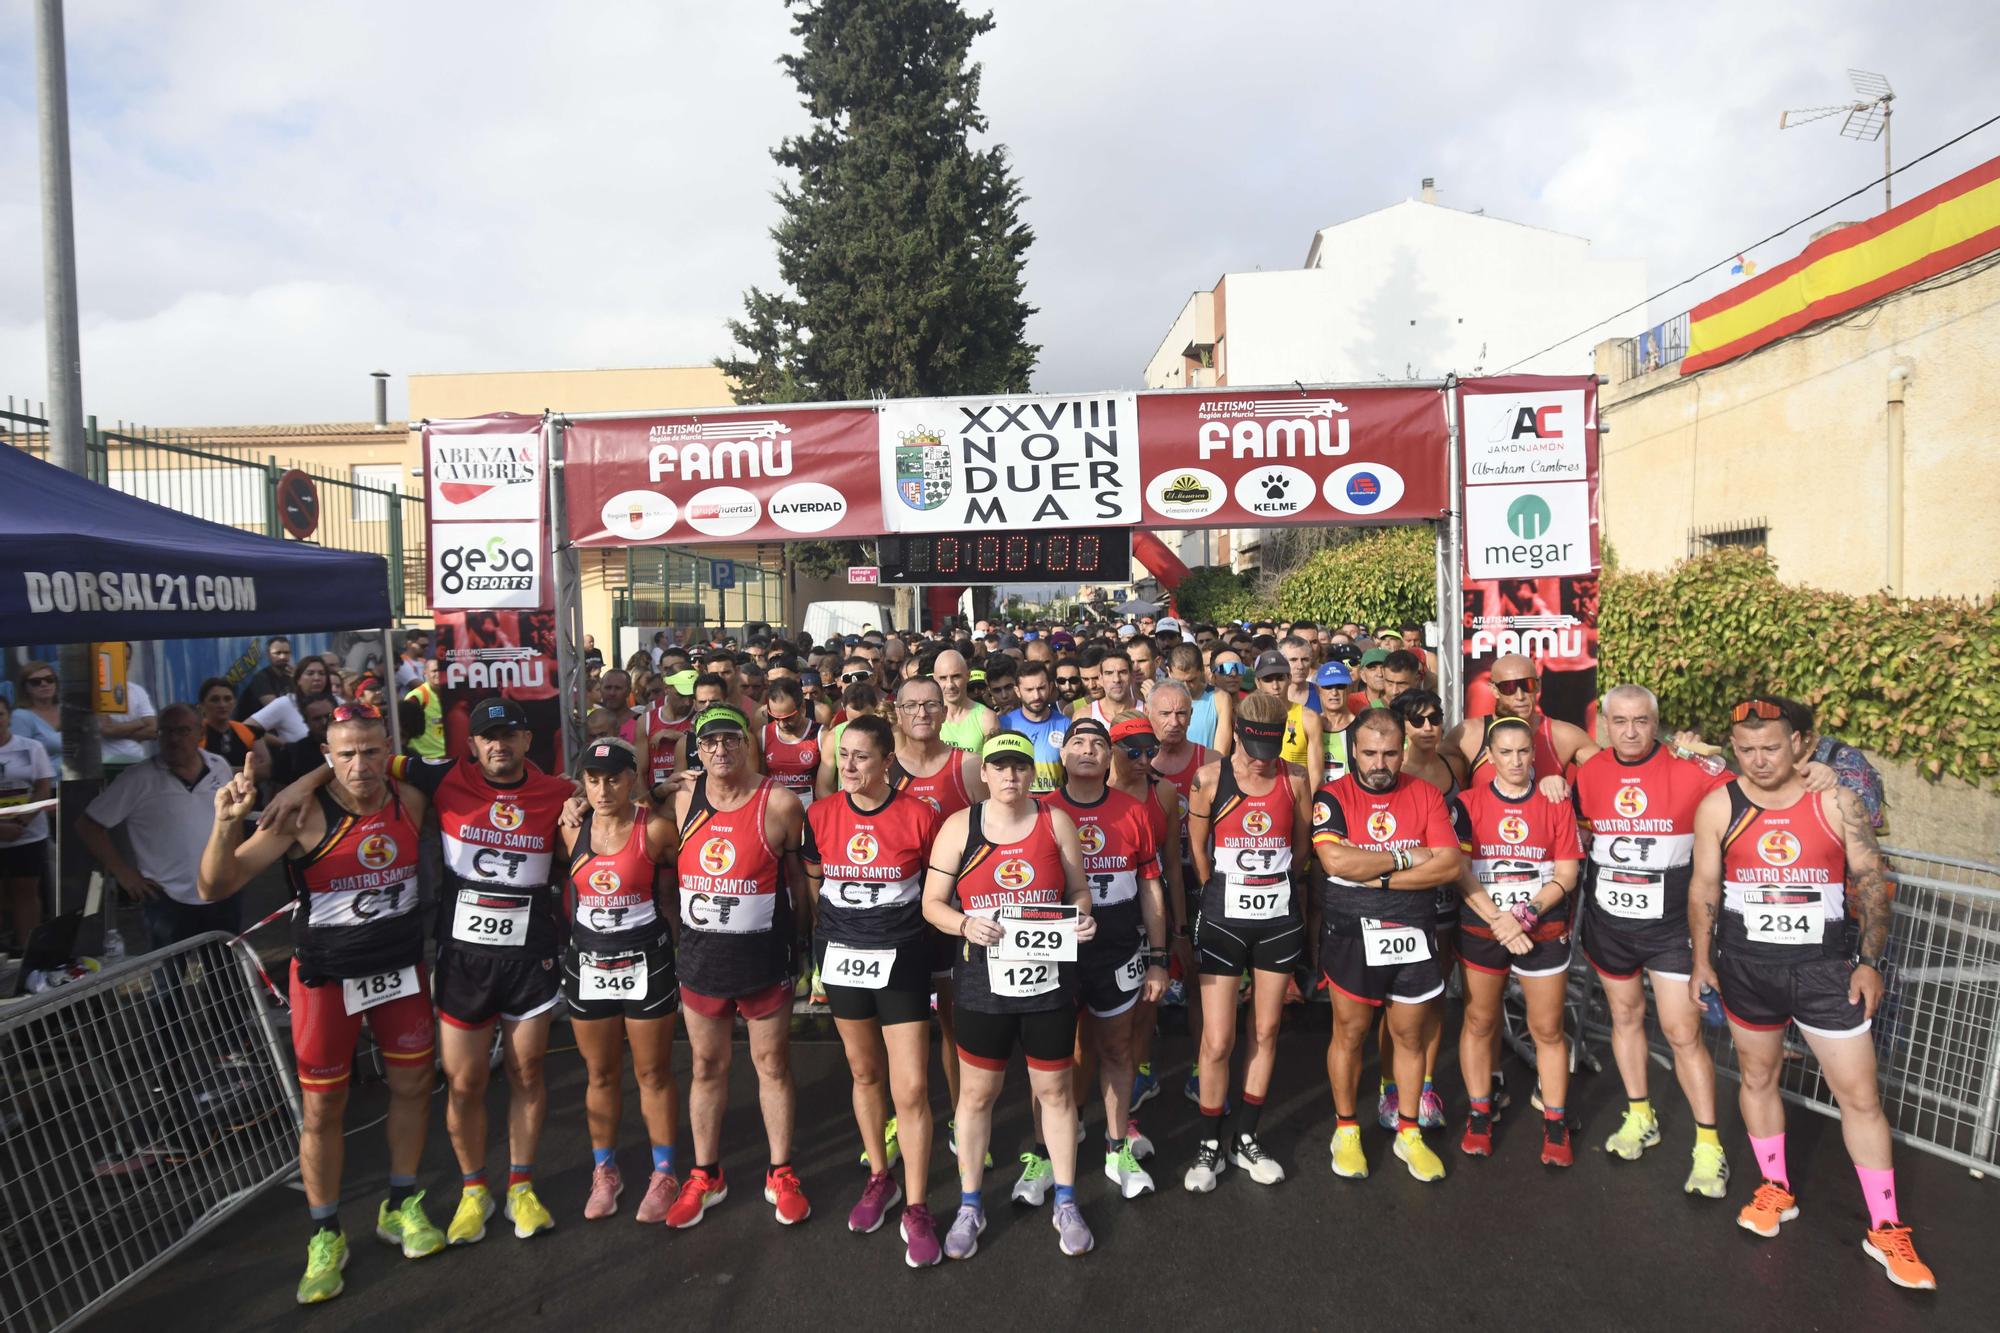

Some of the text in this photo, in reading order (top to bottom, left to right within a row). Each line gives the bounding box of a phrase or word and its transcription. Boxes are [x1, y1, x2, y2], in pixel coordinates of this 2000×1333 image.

[1199, 400, 1255, 412] ATLETISMO
[960, 400, 1117, 434] XXVIII
[1199, 412, 1220, 420] Región
[1511, 405, 1563, 440] AC
[650, 423, 702, 437] ATLETISMO
[650, 435, 671, 443] Región
[680, 434, 702, 442] Murcia
[1199, 418, 1350, 460] FAMU
[963, 430, 1118, 464] NON
[649, 440, 793, 483] FAMU
[1471, 459, 1580, 476] Abraham Cambres
[434, 463, 535, 480] CAMBRES
[965, 461, 1124, 494] DUER
[773, 502, 842, 514] LA VERDAD
[963, 491, 1123, 524] MAS
[1254, 502, 1297, 512] KELME
[1485, 542, 1573, 569] megar
[468, 577, 531, 590] SPORTS
[716, 563, 730, 585] P
[24, 571, 257, 613] DORSAL21.COM
[1472, 616, 1514, 625] ATLETISMO
[1471, 629, 1582, 660] FAMU
[446, 661, 544, 690] FAMU
[996, 739, 1022, 748] ANIMAL
[1593, 819, 1674, 833] CUATRO SANTOS
[459, 824, 545, 849] CUATRO SANTOS
[1224, 836, 1286, 848] CUATRO SANTOS
[1480, 844, 1547, 859] CUATRO SANTOS
[1609, 836, 1657, 863] CT
[473, 848, 527, 879] CT
[1091, 855, 1128, 870] SANTOS
[1236, 849, 1278, 872] CT
[822, 863, 902, 879] CUATRO SANTOS
[1735, 867, 1829, 883] CUATRO SANTOS
[330, 873, 379, 891] CUATRO
[714, 878, 758, 894] SANTOS
[351, 882, 406, 920] CT
[607, 893, 642, 907] SANTOS
[839, 881, 887, 905] CT
[970, 889, 1058, 909] CUATRO SANTOS
[1238, 893, 1279, 910] 507
[1607, 890, 1649, 909] 393
[688, 893, 741, 925] CT
[467, 915, 514, 936] 298
[1759, 914, 1811, 933] 284
[1015, 930, 1063, 950] 629
[1378, 937, 1417, 955] 200
[836, 958, 881, 978] 494
[1004, 965, 1048, 987] 122
[356, 971, 402, 998] 183
[593, 975, 636, 991] 346
